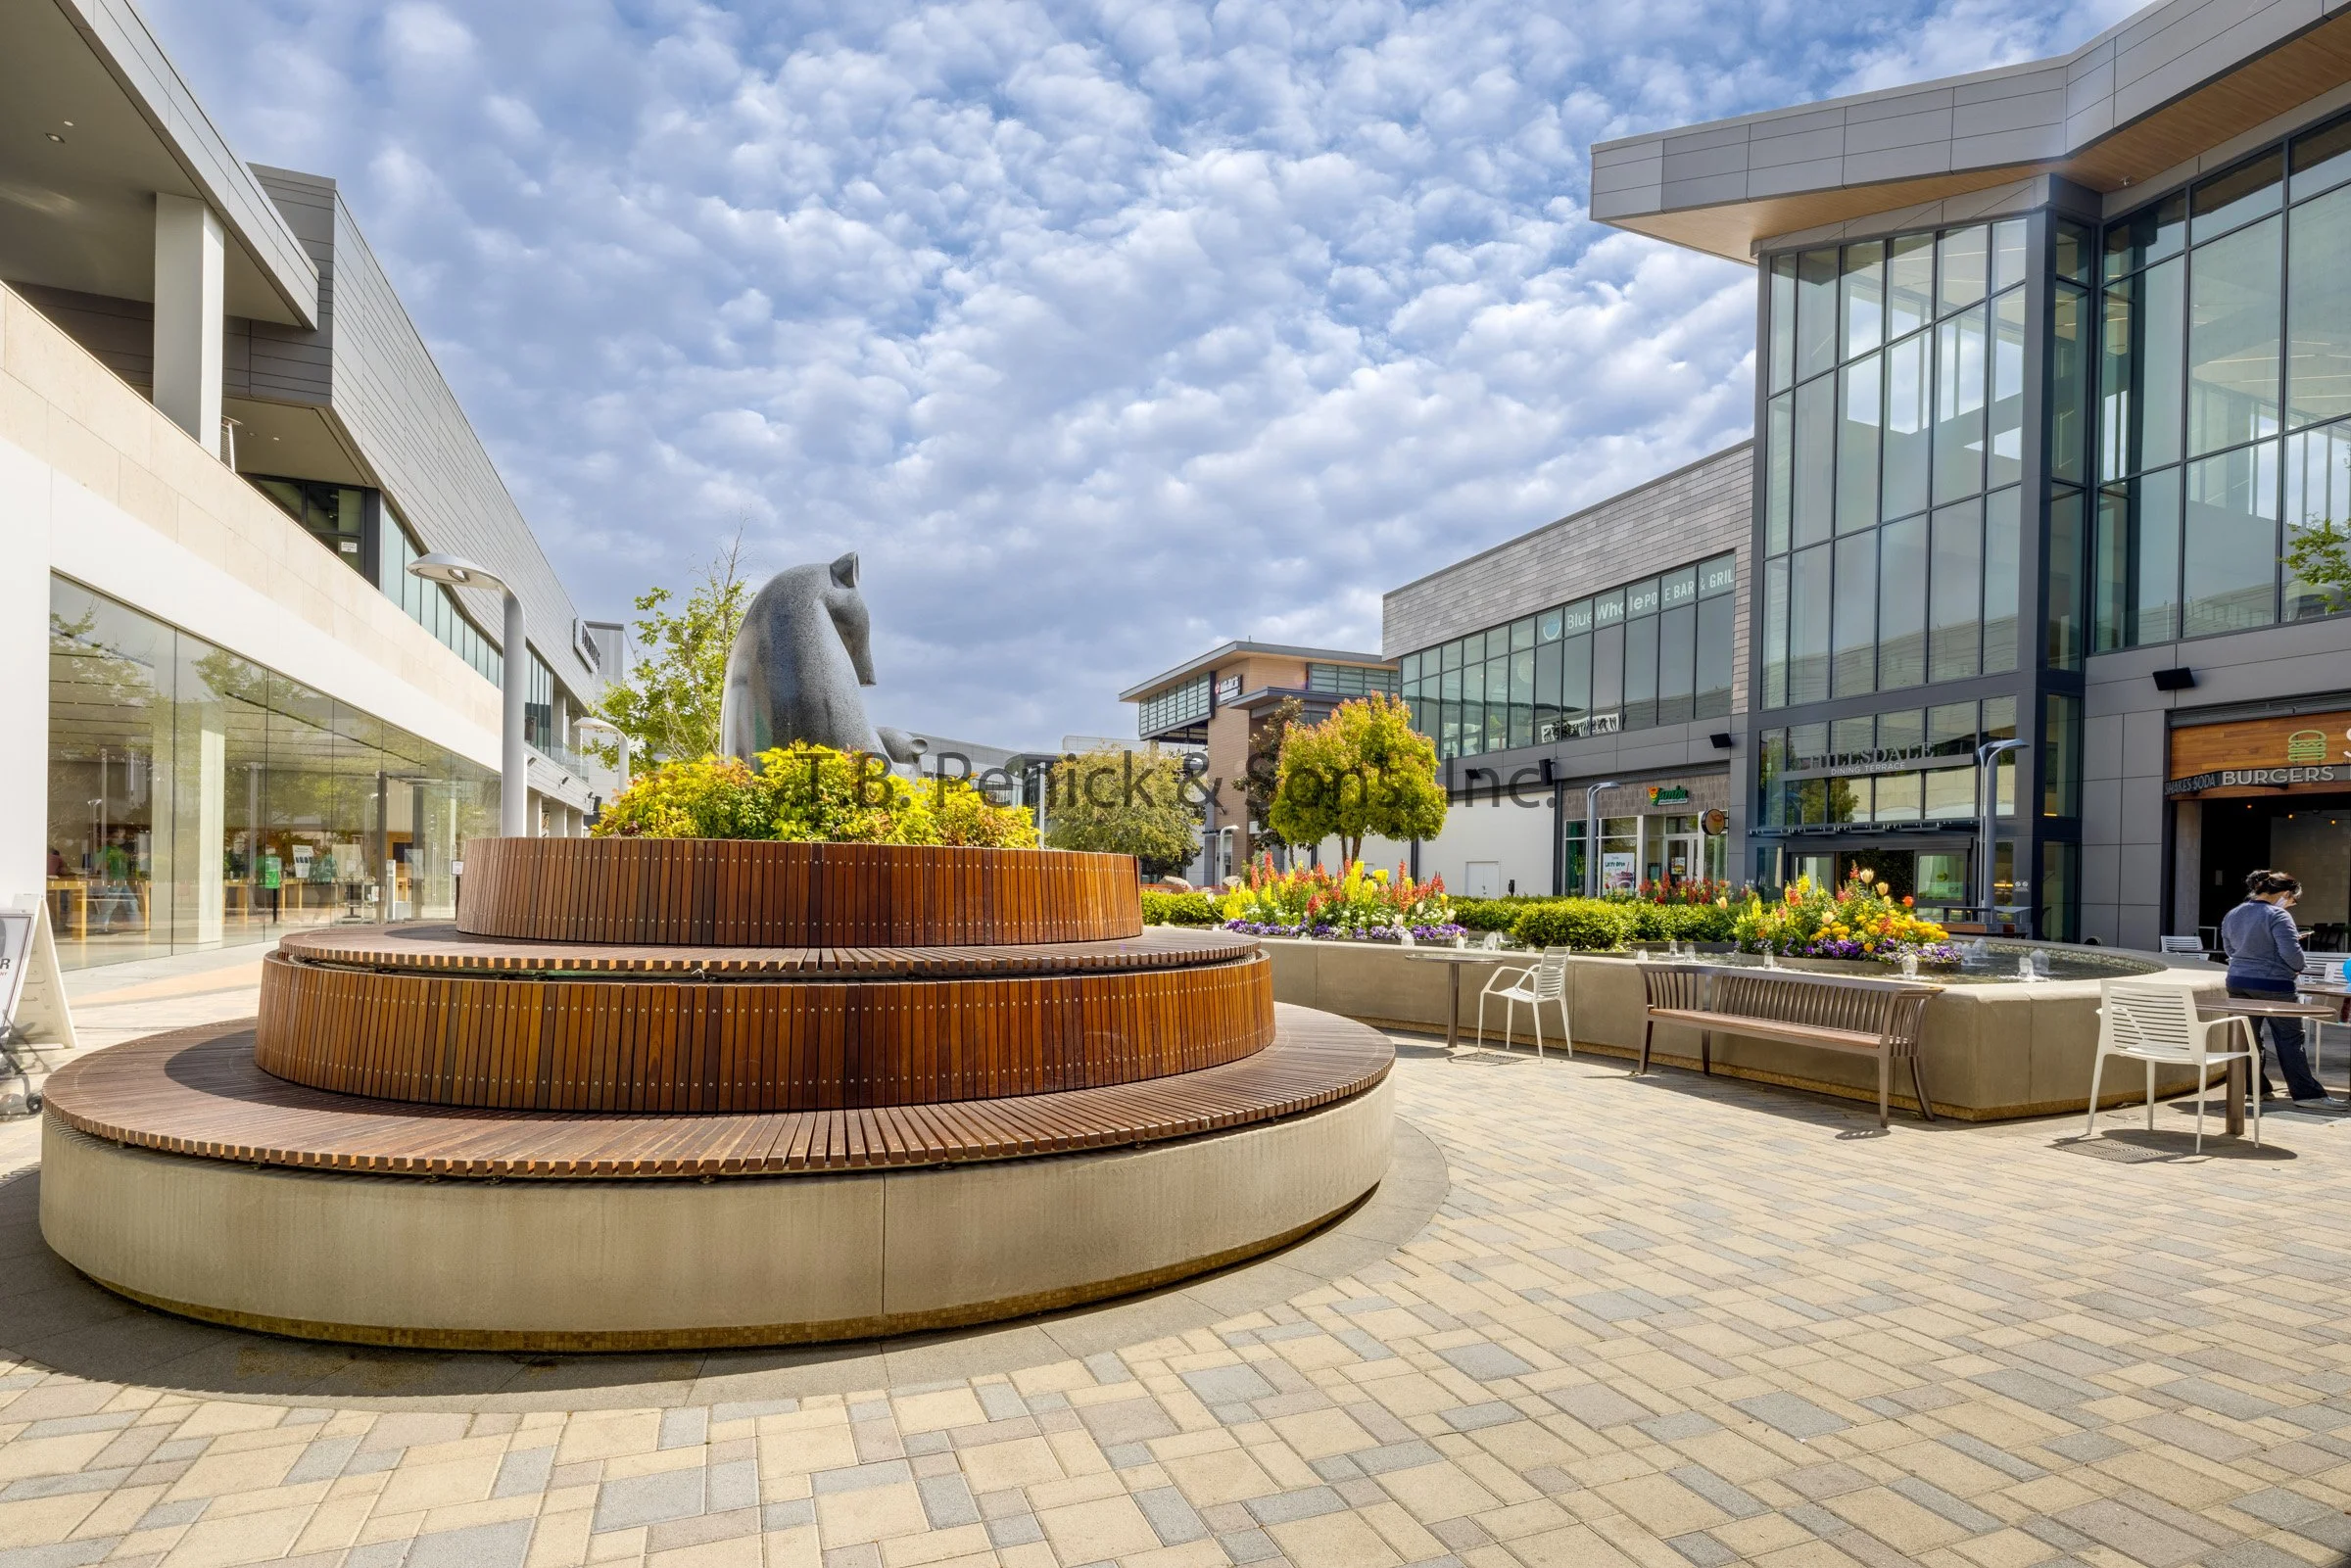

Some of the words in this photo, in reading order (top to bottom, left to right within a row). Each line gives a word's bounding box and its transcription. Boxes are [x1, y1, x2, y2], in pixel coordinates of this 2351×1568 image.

[1567, 610, 1592, 630] Blue
[1645, 588, 1670, 607] POE
[1673, 581, 1695, 598] BAR
[1709, 569, 1734, 588] GRIL
[1811, 742, 1935, 768] HILLSDALE
[1831, 766, 1861, 776] DINING
[1864, 761, 1905, 772] TERRACE
[2165, 778, 2191, 795] SHAKES
[2193, 774, 2215, 790] SODA
[2223, 766, 2334, 785] BURGERS
